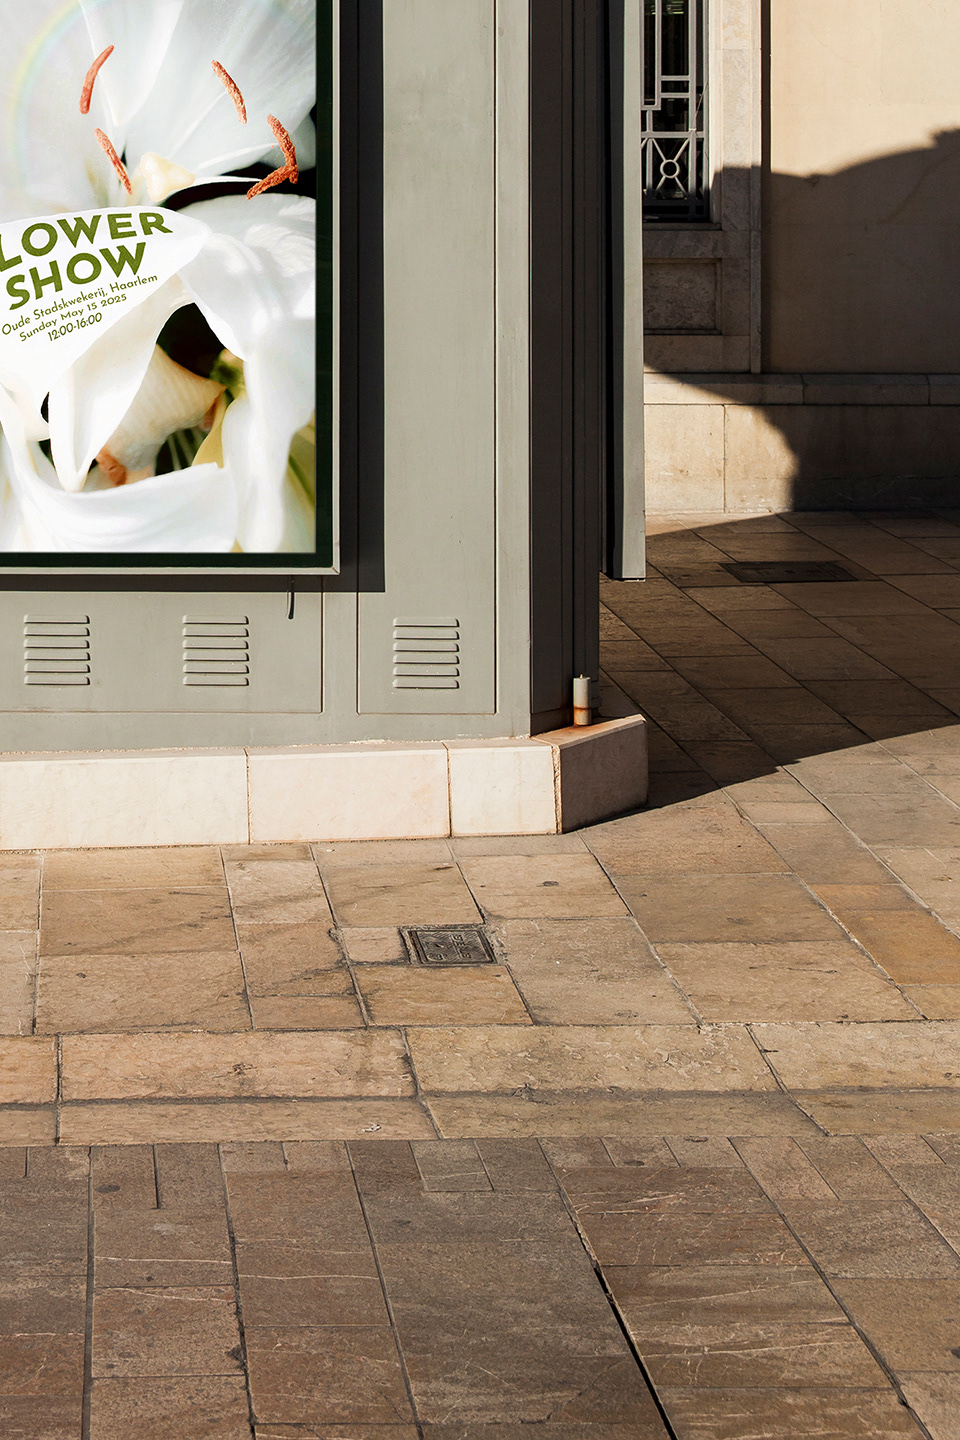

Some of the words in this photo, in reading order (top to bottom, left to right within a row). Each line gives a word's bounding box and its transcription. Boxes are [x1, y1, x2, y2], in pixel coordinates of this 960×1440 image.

[6, 242, 146, 311] SHOW
[1, 315, 31, 335] Oude
[33, 287, 108, 320] Stadskwekerij,
[109, 275, 158, 293] Haarlem
[19, 319, 57, 342] Sunday
[60, 308, 84, 320] May
[87, 302, 98, 311] 15
[100, 293, 127, 308] 2025
[47, 312, 103, 341] 12:00-16:00
